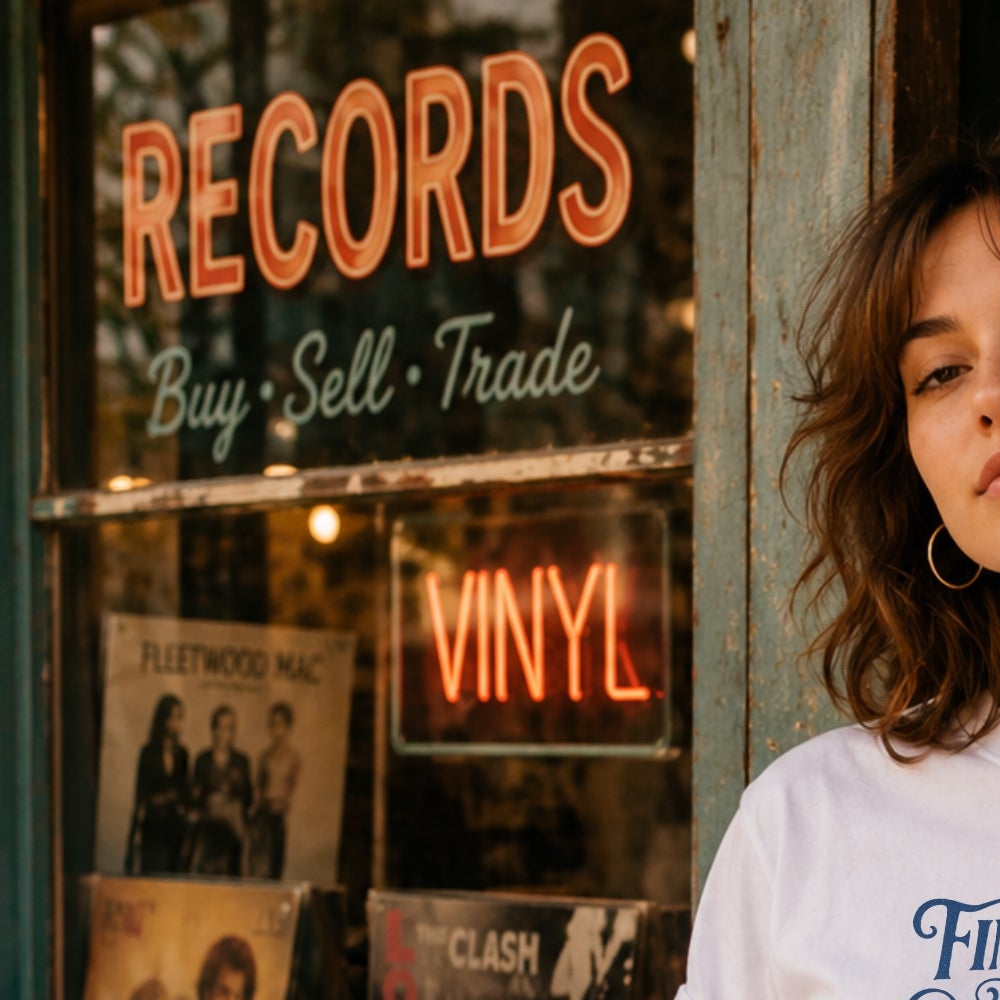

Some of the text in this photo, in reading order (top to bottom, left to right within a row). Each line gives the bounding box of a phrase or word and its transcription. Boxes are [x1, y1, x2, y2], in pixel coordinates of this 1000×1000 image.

[122, 32, 632, 307] RECORDS
[147, 307, 600, 463] Buy Sell Trade
[426, 562, 650, 704] VINYL
[449, 927, 541, 975] CLASH
